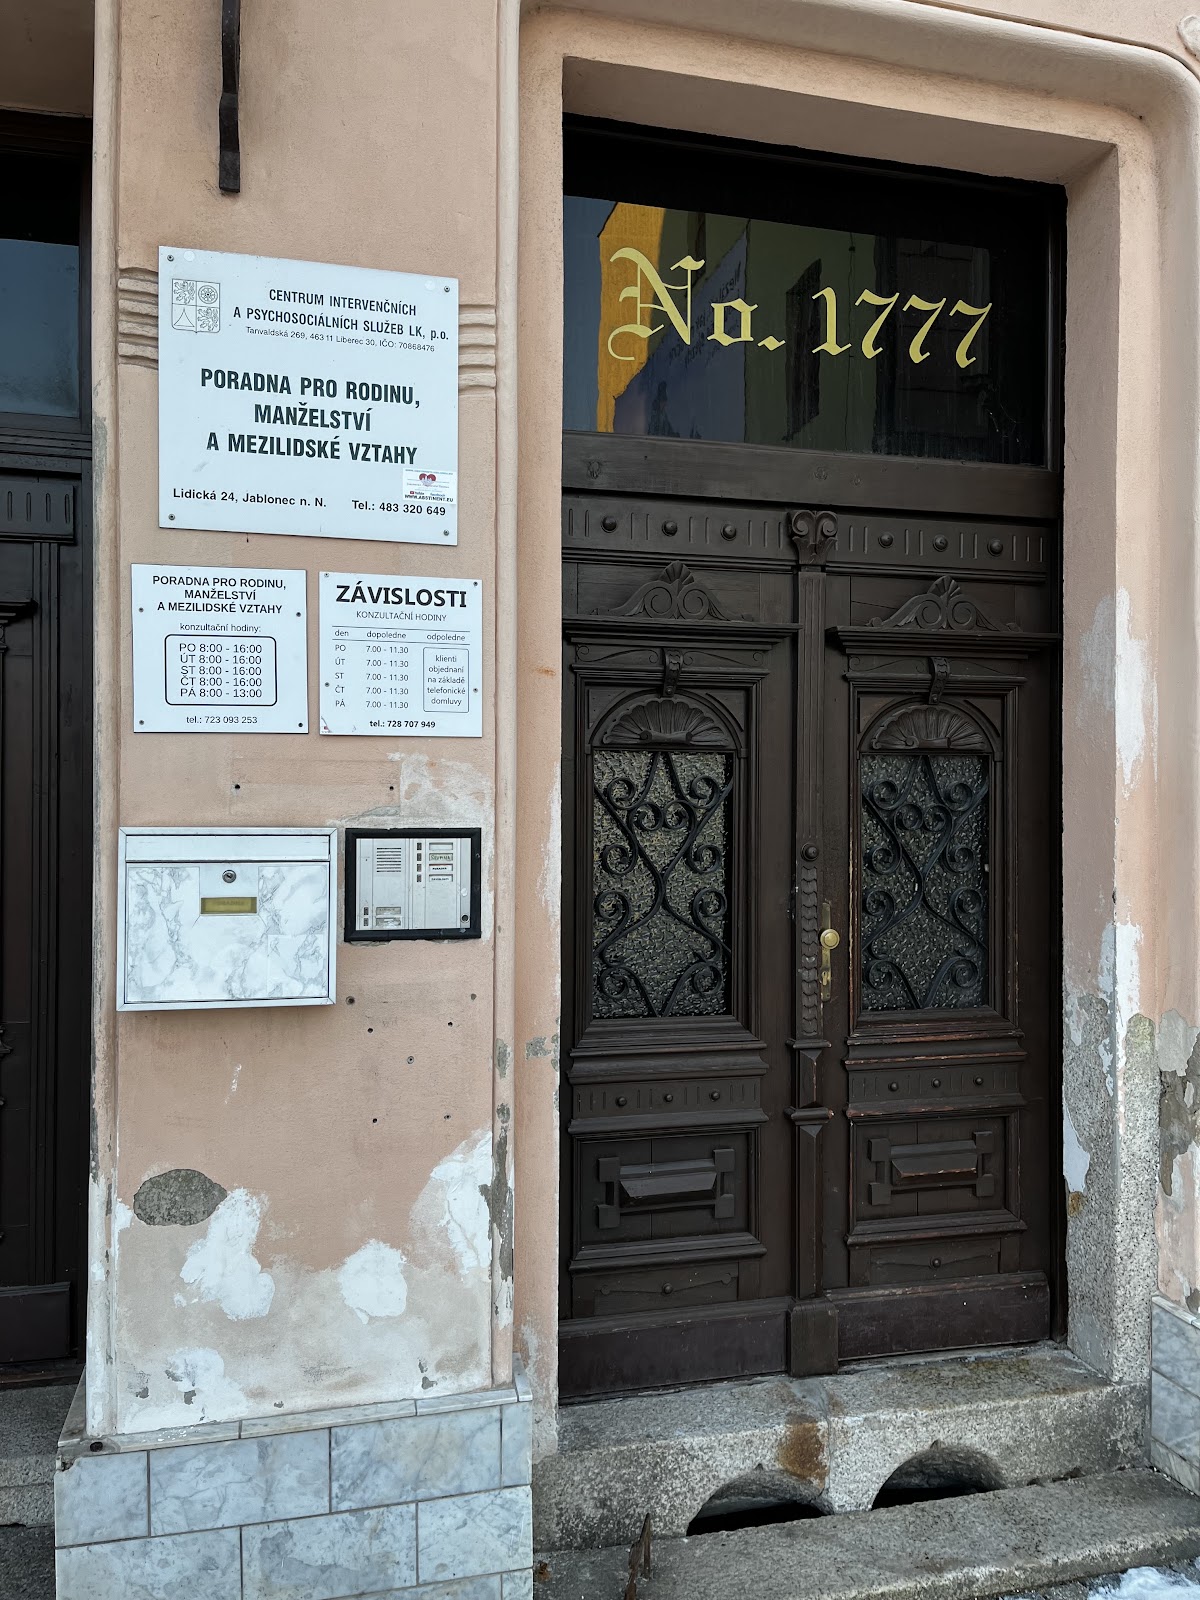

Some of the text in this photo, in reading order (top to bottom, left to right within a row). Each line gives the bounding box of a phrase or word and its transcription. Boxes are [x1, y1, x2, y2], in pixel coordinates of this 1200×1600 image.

[269, 289, 416, 316] CENTRUM INTERVENČNÍCH
[607, 247, 786, 361] No.
[811, 287, 993, 369] 1777
[233, 306, 449, 340] A PSYCHOSOCIÁLNÍCH SLUŽEB LK, p.o.
[246, 326, 289, 338] Tanvaldská
[290, 331, 308, 340] 269,
[309, 333, 324, 341] 463
[336, 336, 364, 345] Liberec
[365, 338, 377, 347] 30,
[379, 339, 397, 348] IČO:
[201, 368, 420, 408] PORADNA PRO RODINU,
[254, 402, 373, 432] MANŽELSTVÍ
[206, 432, 418, 465] A MEZILIDSKÉ VZTAHY
[173, 488, 327, 507] Lidická 24, Jablonec n. N.
[351, 500, 446, 516] Tel.: 483 320 649
[152, 576, 286, 590] PORADNA PRO RODINU,
[184, 588, 256, 600] MANŽELSTVÍ
[336, 581, 467, 608] ZÁVISLOSTI
[157, 602, 282, 613] A MEZILIDSKÉ VZTAHY
[356, 611, 413, 620] KONZULTAČNÍ
[180, 623, 261, 633] konzultační hodiny:
[367, 631, 406, 639] dopoledne
[427, 633, 465, 642] odpoledne
[179, 643, 196, 652] PO
[199, 644, 222, 653] 8:00
[233, 644, 262, 653] 16:00
[180, 653, 196, 663] ÚT
[199, 655, 222, 664] 8:00
[233, 656, 261, 664] 16:00
[335, 657, 345, 665] ÚT
[180, 666, 196, 675] ST
[199, 666, 222, 675] 8:00
[233, 667, 261, 675] 16:00
[428, 666, 464, 674] objednaní
[180, 675, 196, 686] ČT
[199, 677, 222, 686] 8:00
[233, 678, 262, 686] 16:00
[438, 676, 465, 684] základě
[180, 687, 196, 697] PÁ
[199, 688, 222, 697] 8:00
[233, 689, 262, 697] 13:00
[335, 685, 345, 694] ČT
[427, 687, 466, 695] telefonické
[336, 699, 345, 707] PÁ
[431, 698, 462, 706] domluvy
[223, 716, 239, 724] 093
